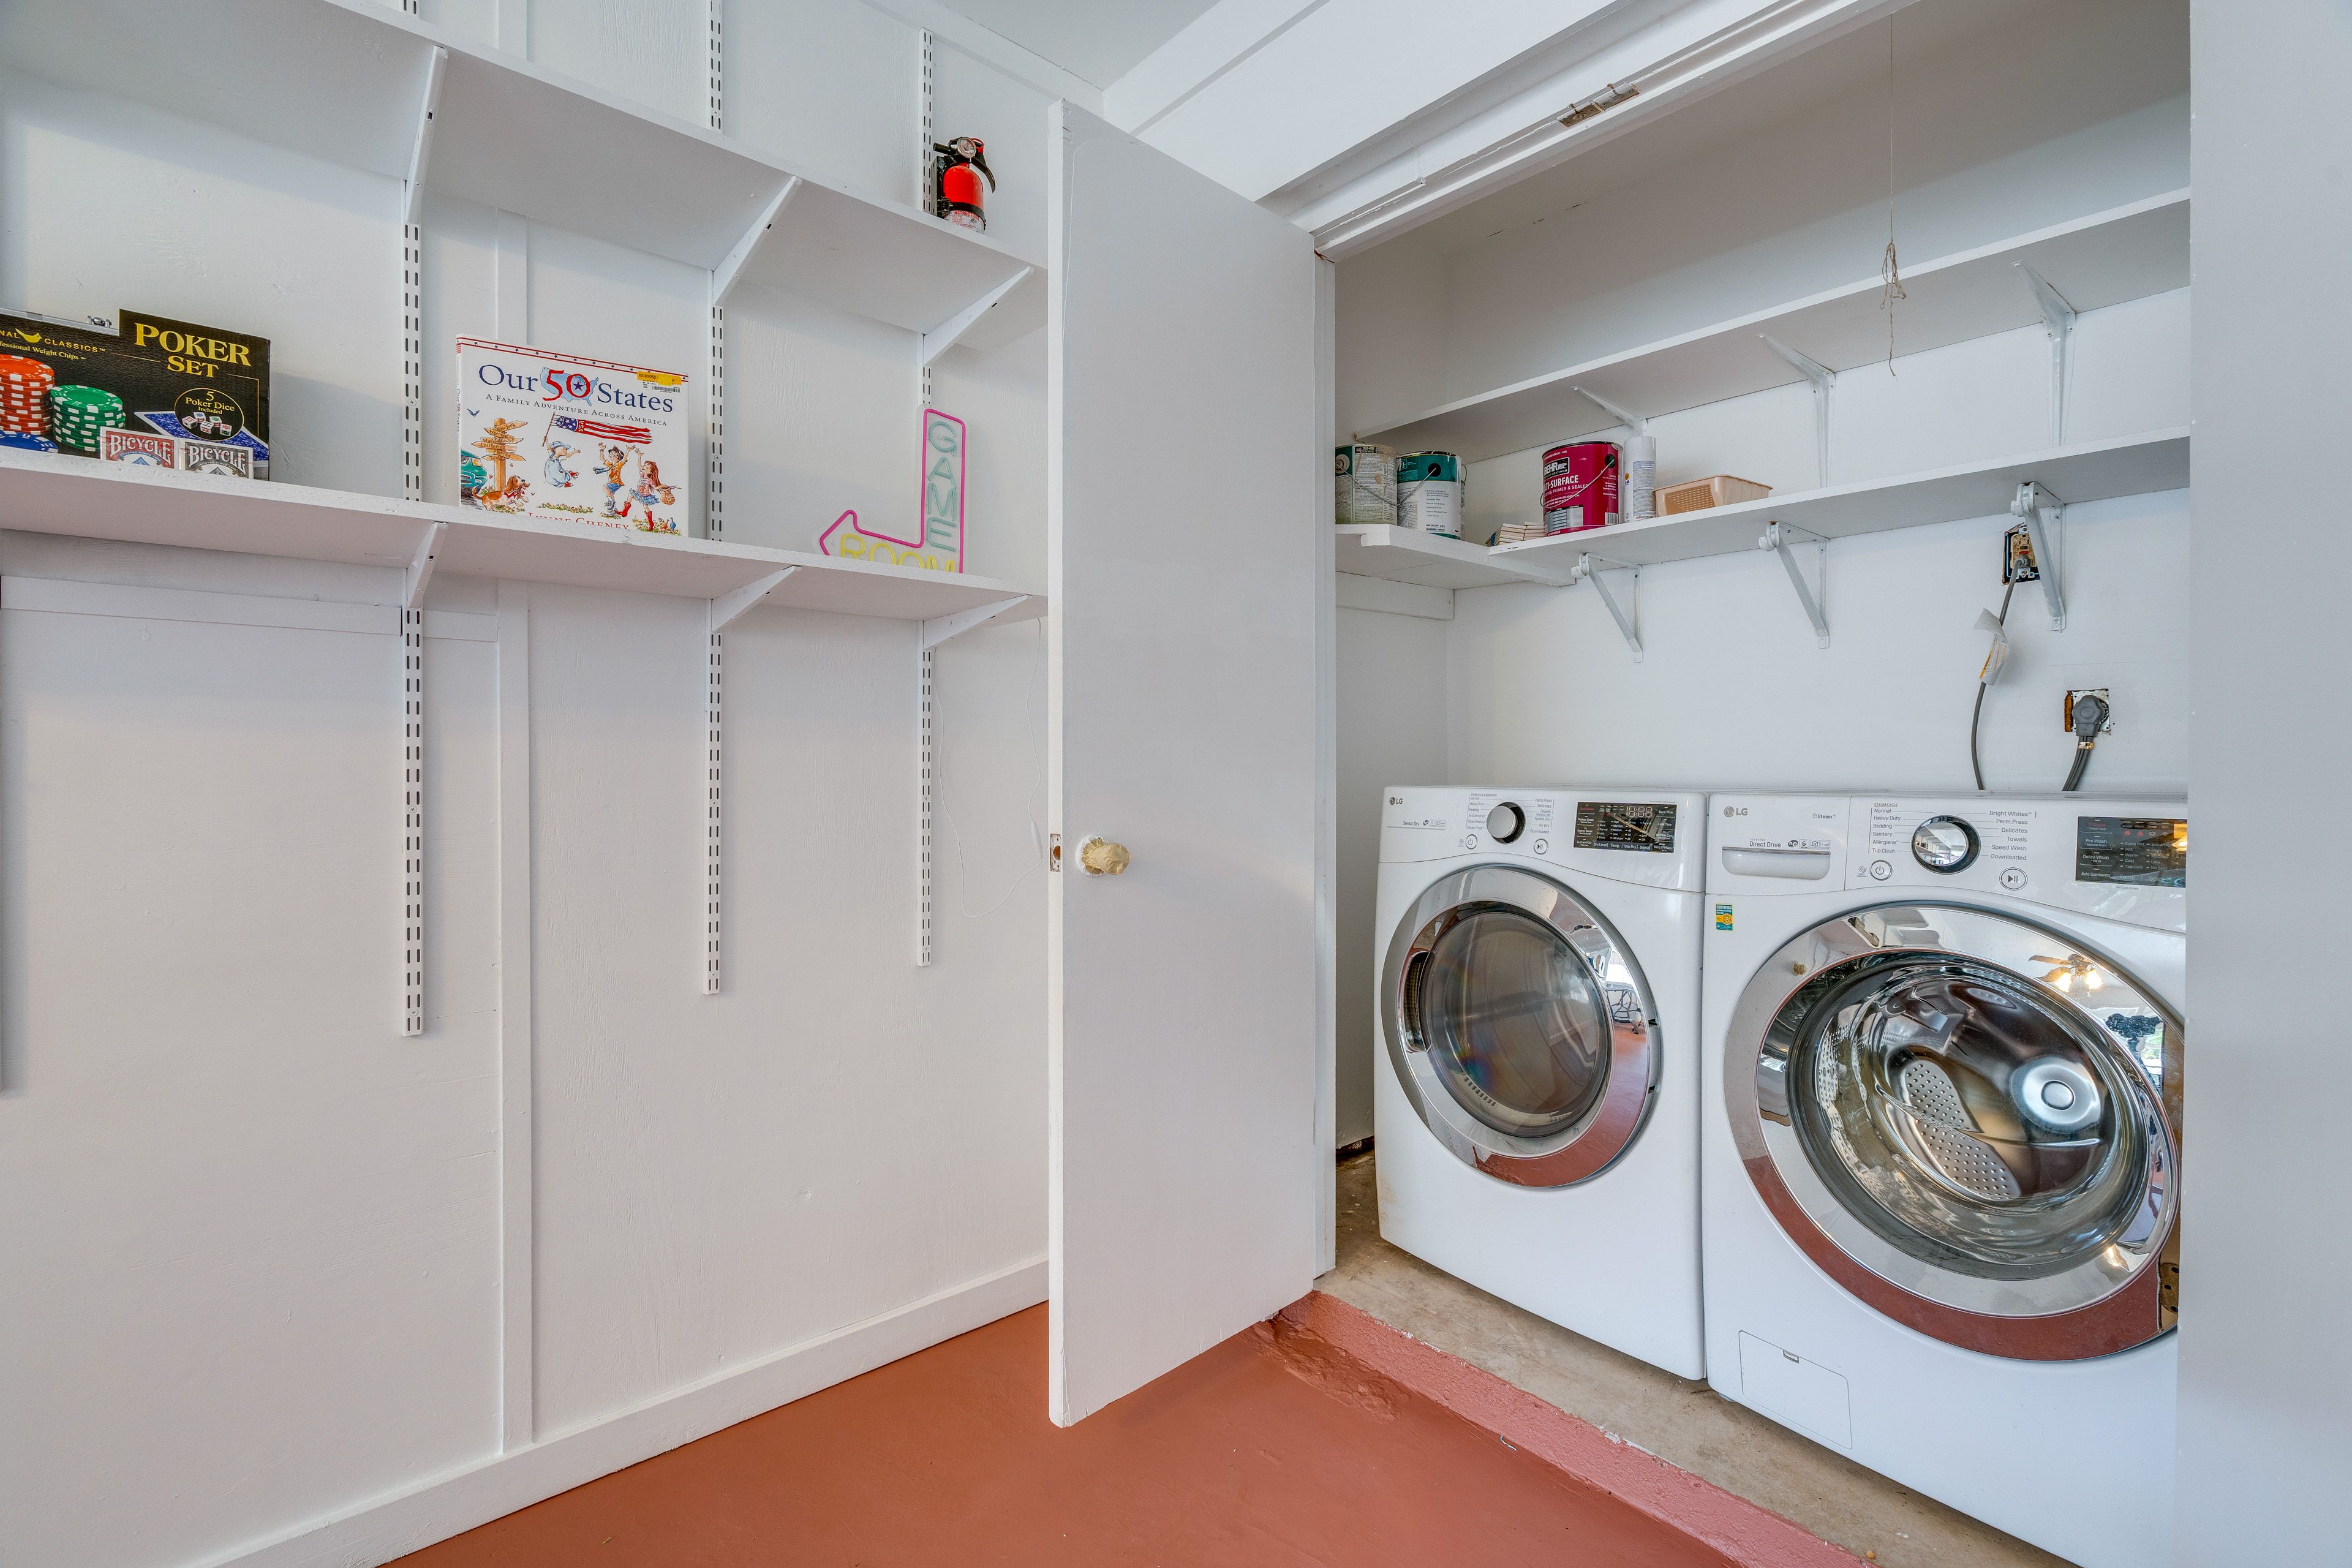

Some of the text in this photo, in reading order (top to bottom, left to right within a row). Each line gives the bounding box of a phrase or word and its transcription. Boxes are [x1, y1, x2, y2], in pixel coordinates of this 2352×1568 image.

[32, 347, 58, 356] Weight
[58, 352, 79, 360] Chips
[134, 322, 251, 366] POKER
[167, 356, 219, 379] SET
[206, 391, 214, 401] 5
[478, 364, 538, 391] Our
[541, 369, 591, 402] 50
[597, 382, 673, 412] States
[186, 397, 235, 411] Poker Dice
[496, 395, 530, 407] FAMILY
[533, 400, 589, 415] ADVENTURE
[592, 409, 625, 420] ACROSS
[628, 415, 667, 426] AMERICA
[110, 435, 172, 466] BICYCLE
[189, 445, 246, 475] BICYCLE
[1544, 462, 1558, 476] BEHR
[927, 421, 957, 552] GAME
[1544, 475, 1578, 491] LTI-SURFACE
[1735, 807, 1748, 816] LG
